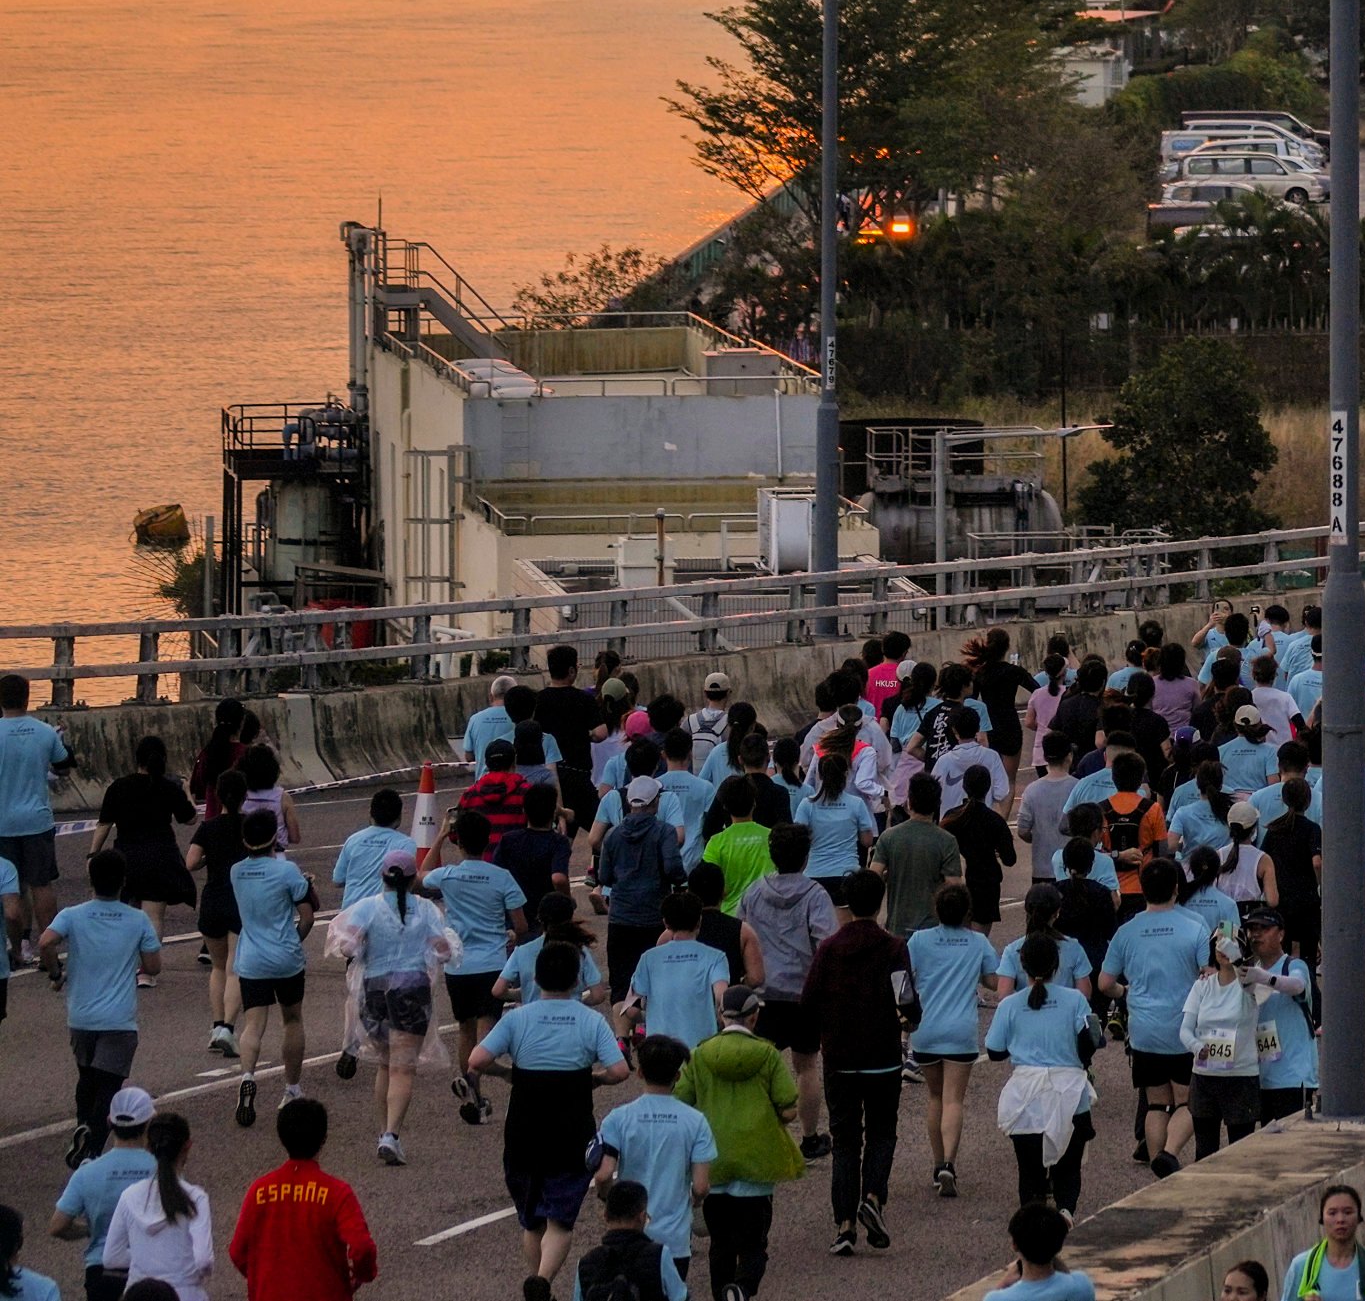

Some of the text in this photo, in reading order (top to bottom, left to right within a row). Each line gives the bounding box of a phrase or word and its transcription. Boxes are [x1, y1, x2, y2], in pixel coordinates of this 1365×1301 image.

[1332, 419, 1343, 533] 47688 A
[875, 679, 898, 688] HKUST
[256, 1181, 329, 1205] ESPAÑA
